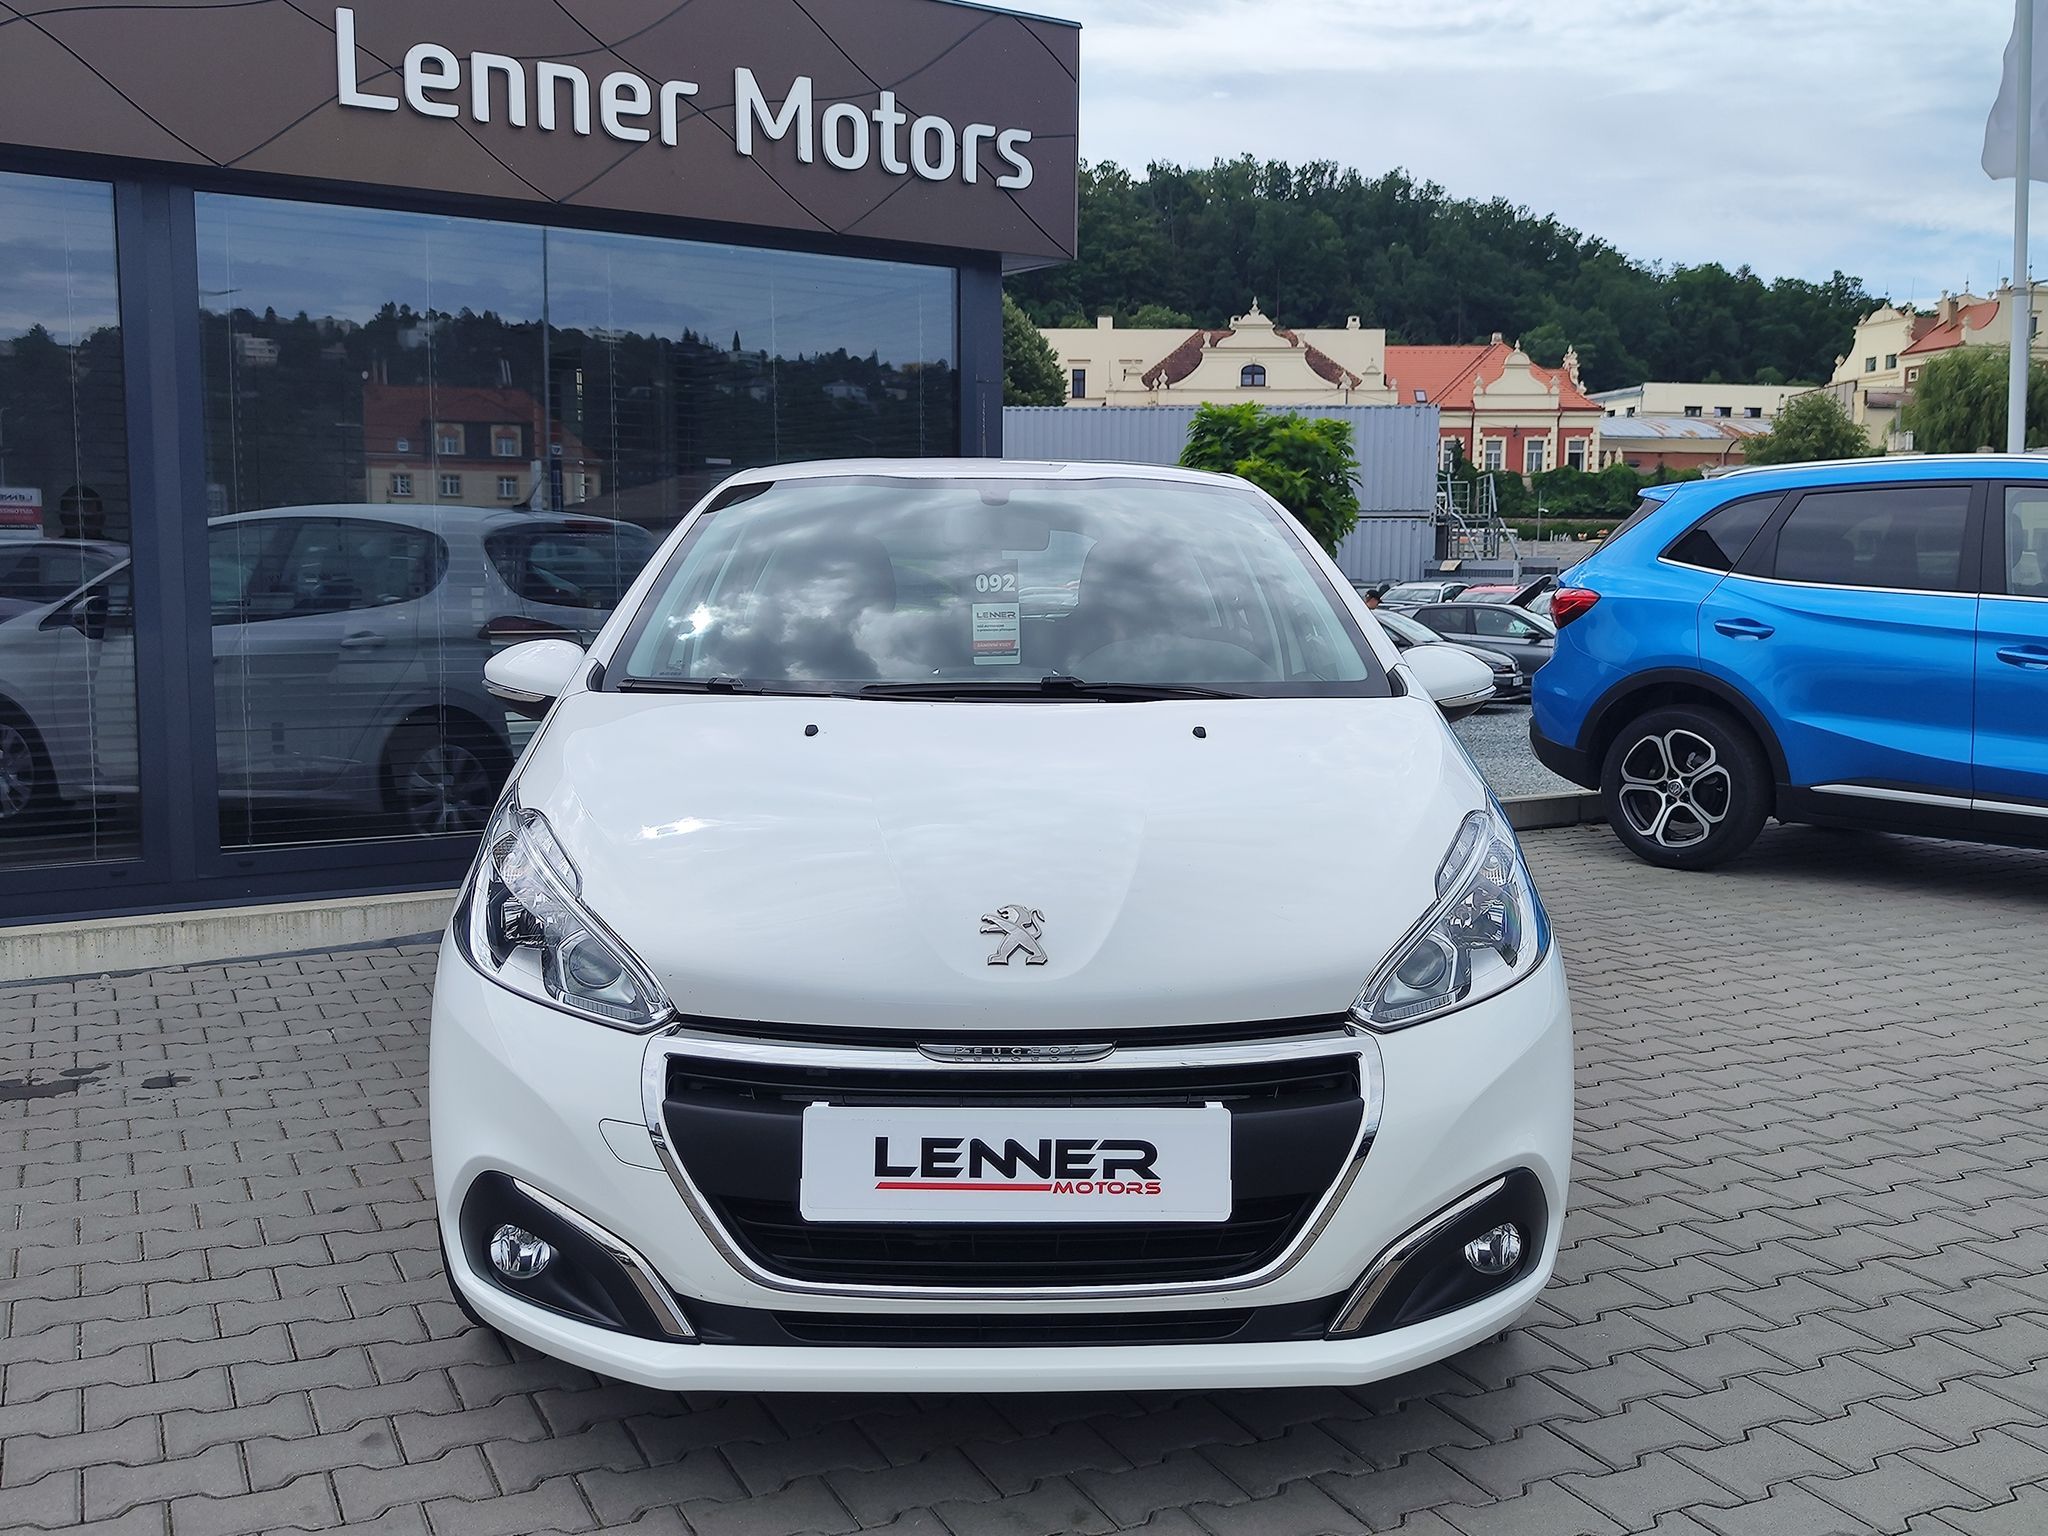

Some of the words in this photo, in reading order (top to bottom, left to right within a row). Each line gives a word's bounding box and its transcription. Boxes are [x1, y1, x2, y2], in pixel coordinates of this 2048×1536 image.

[335, 7, 699, 146] Lenner
[734, 67, 1034, 190] Motors
[975, 574, 1016, 593] 092
[976, 611, 1017, 619] LENNER
[954, 1046, 1079, 1056] PEUGEOT
[874, 1136, 1161, 1179] LENNER
[1053, 1181, 1162, 1195] MOTORS
